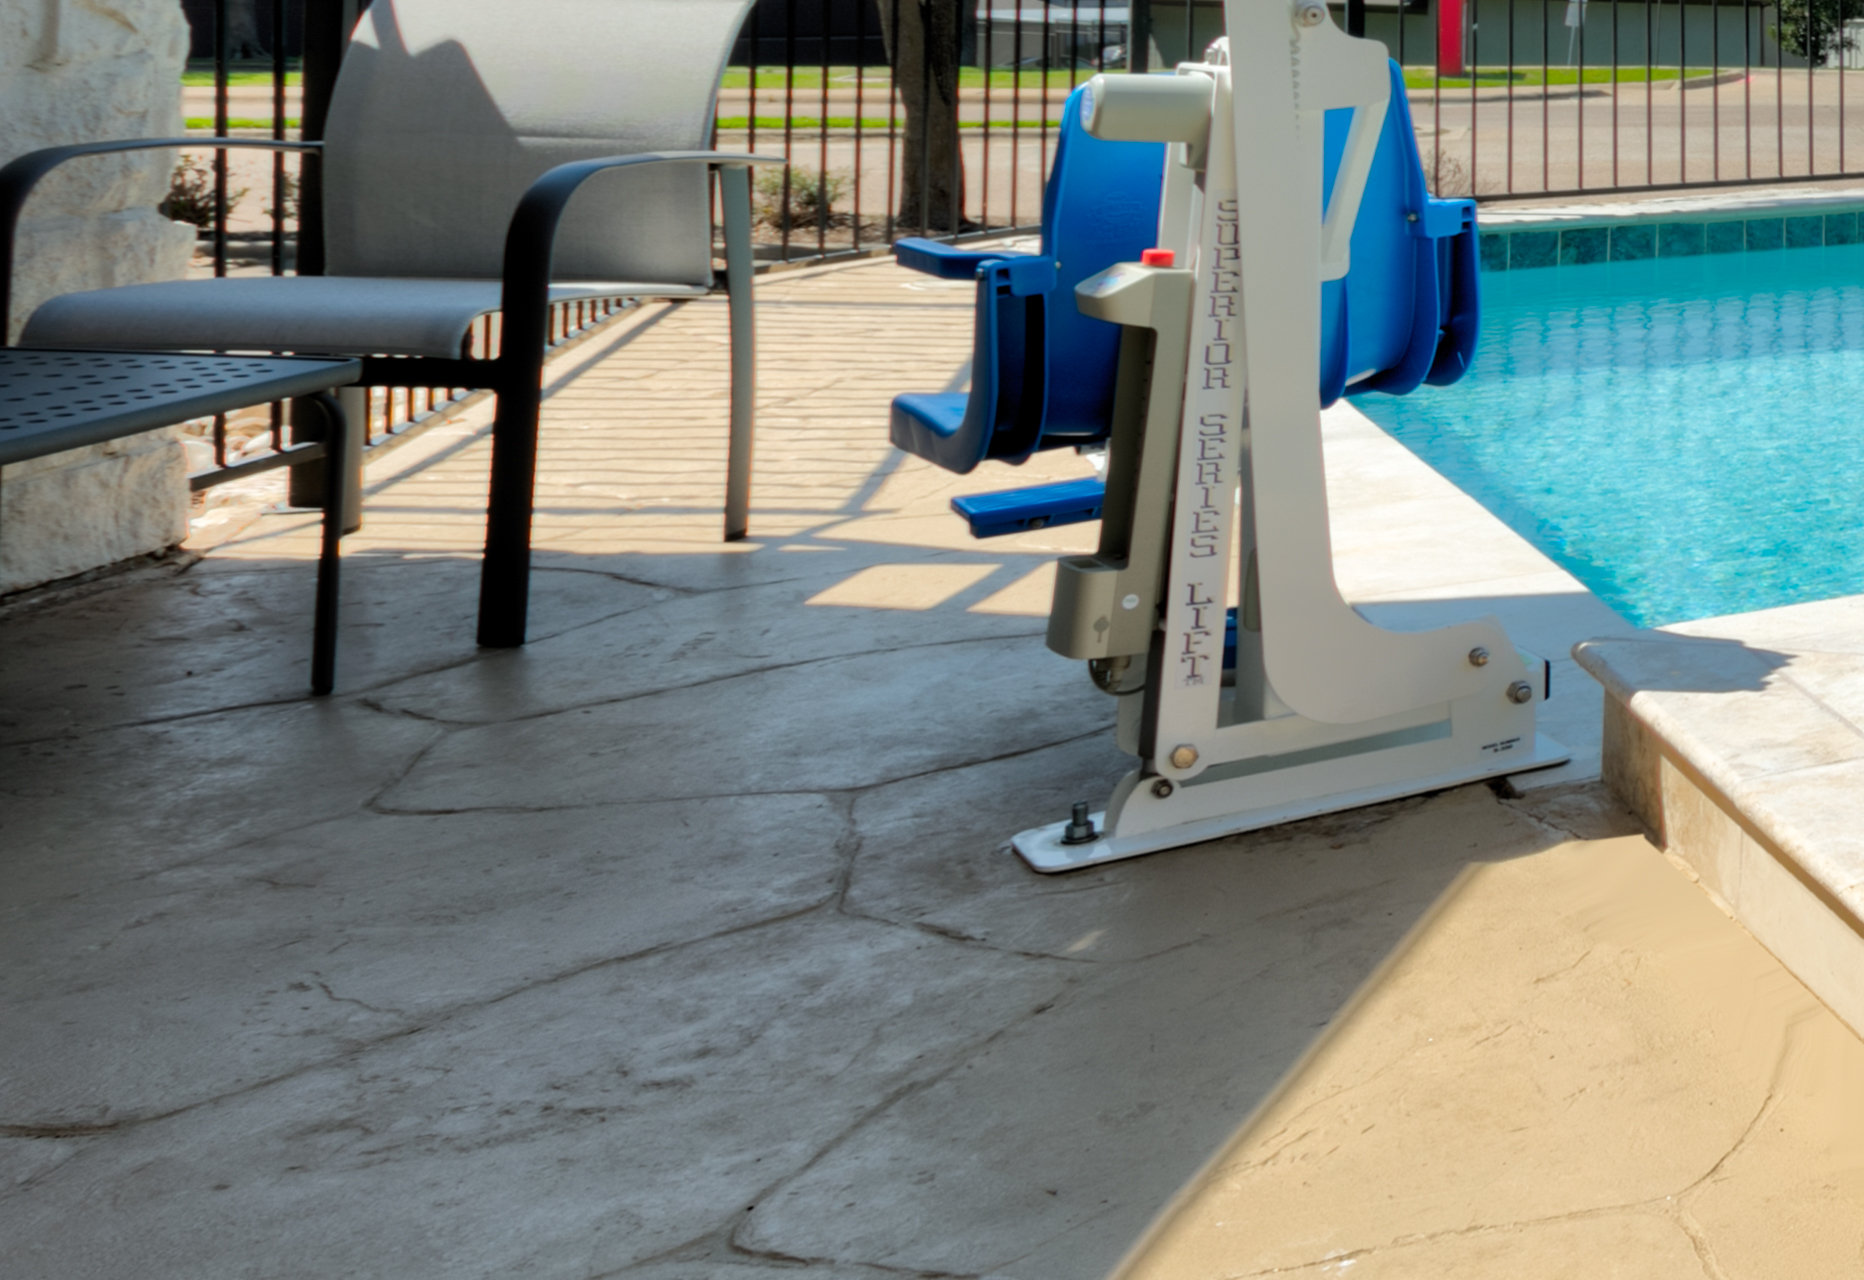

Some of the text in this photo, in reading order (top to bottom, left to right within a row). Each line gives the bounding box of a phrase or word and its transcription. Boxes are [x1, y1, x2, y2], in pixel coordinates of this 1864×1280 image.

[1202, 199, 1240, 390] SUPERIOR
[1189, 414, 1228, 558] SERIES
[1180, 582, 1214, 678] LIFT
